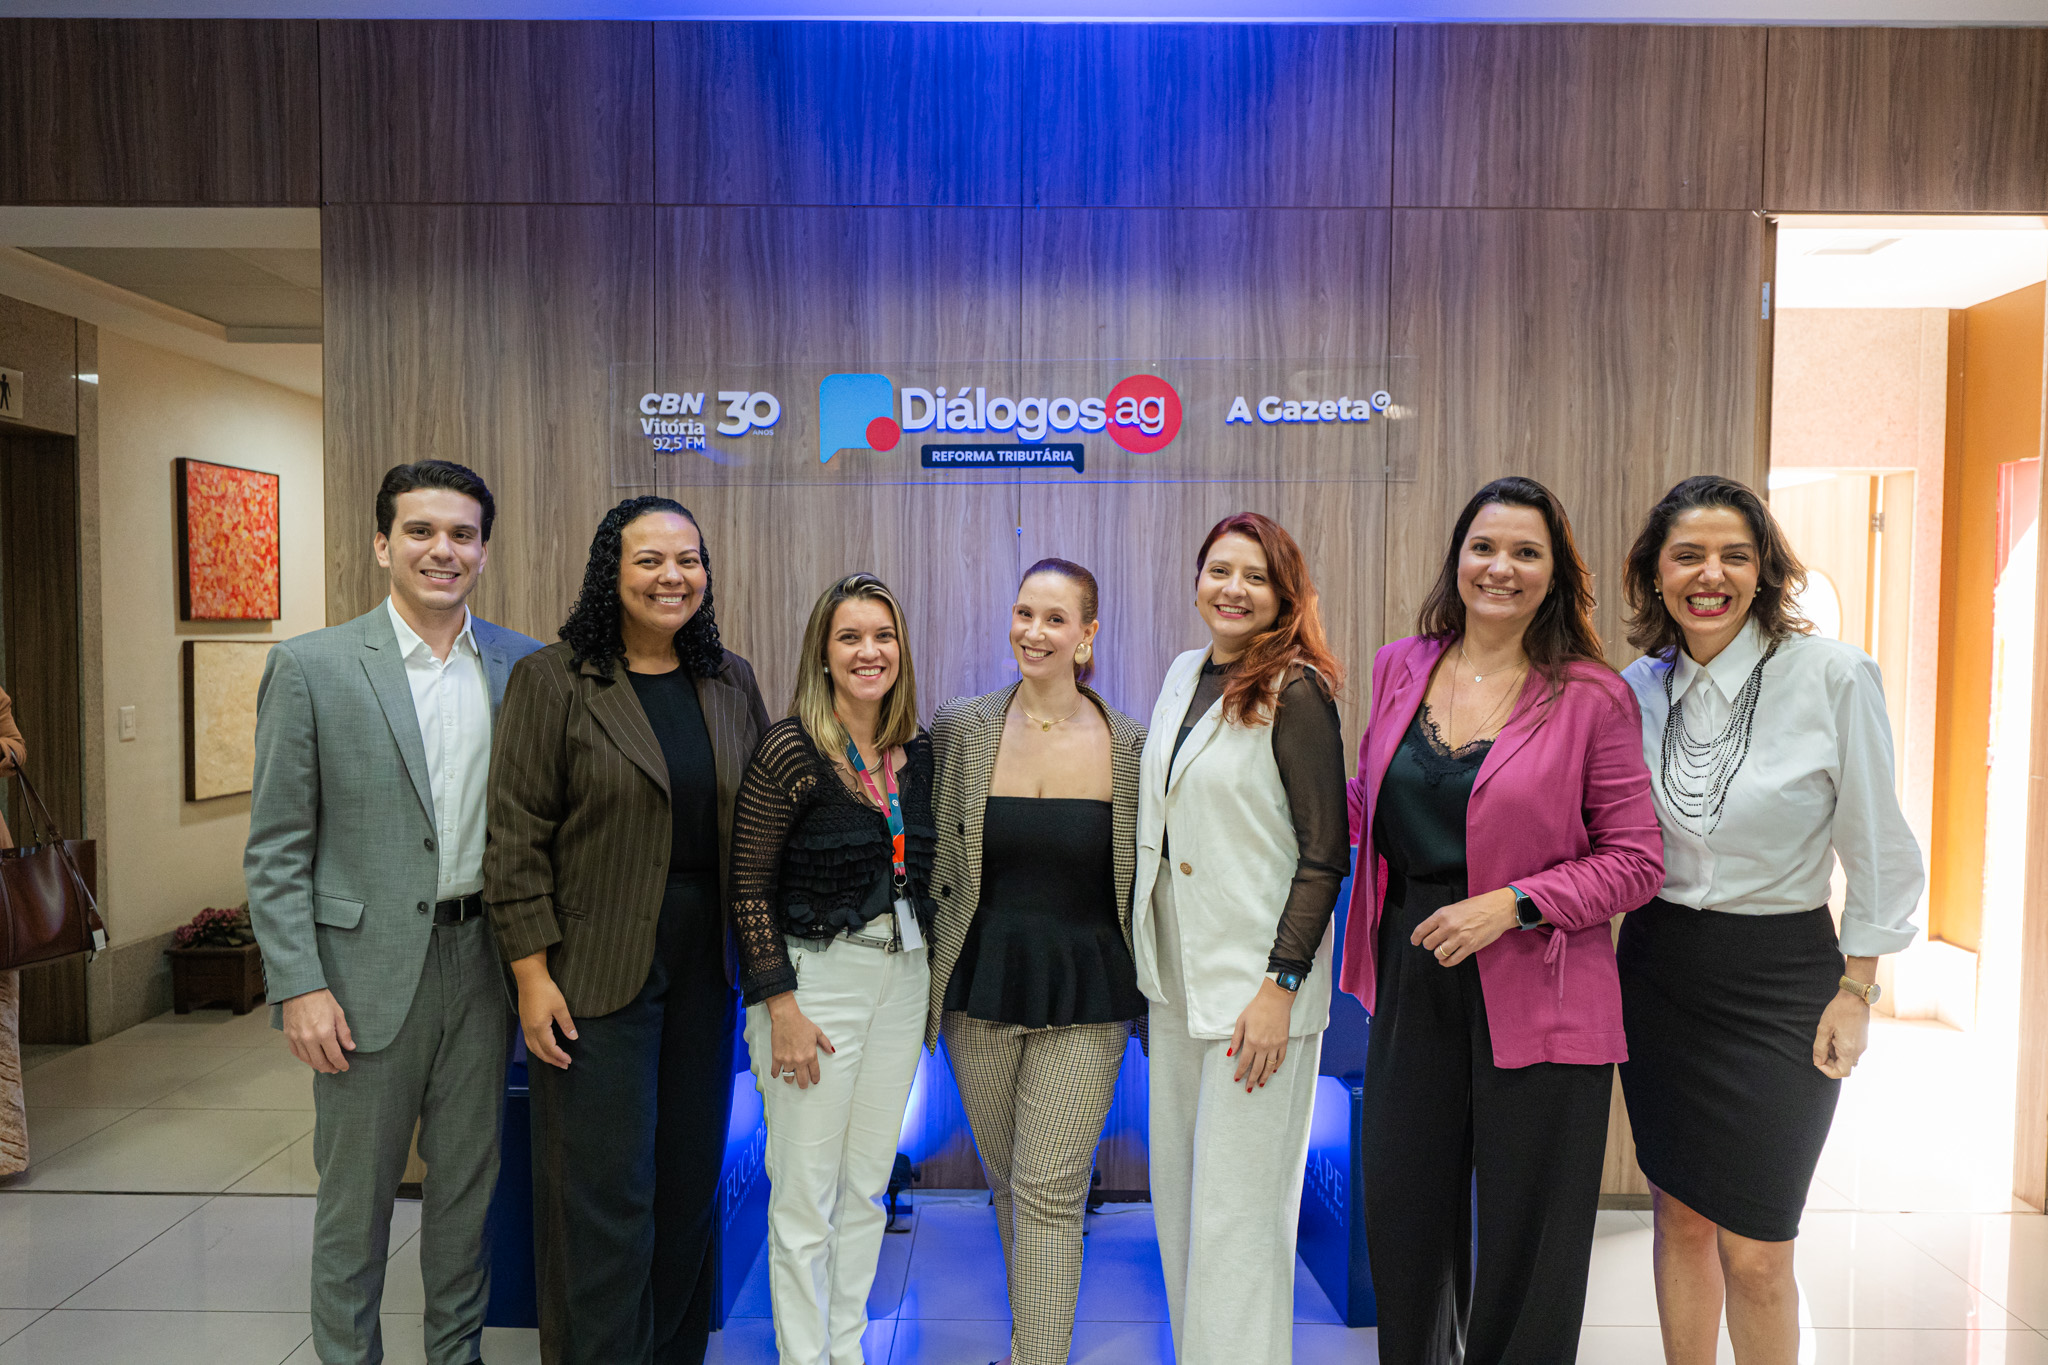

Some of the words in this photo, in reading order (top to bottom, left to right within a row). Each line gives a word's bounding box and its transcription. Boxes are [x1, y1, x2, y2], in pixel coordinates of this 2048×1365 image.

[640, 392, 705, 415] CBN
[1225, 396, 1253, 423] A
[1257, 396, 1371, 423] Gazeta
[716, 391, 781, 437] 30
[640, 418, 706, 436] Vitória
[653, 436, 682, 452] 92,5
[685, 436, 706, 450] FM
[931, 450, 995, 462] REFORMA
[997, 447, 1075, 462] TRIBUTÁRIA
